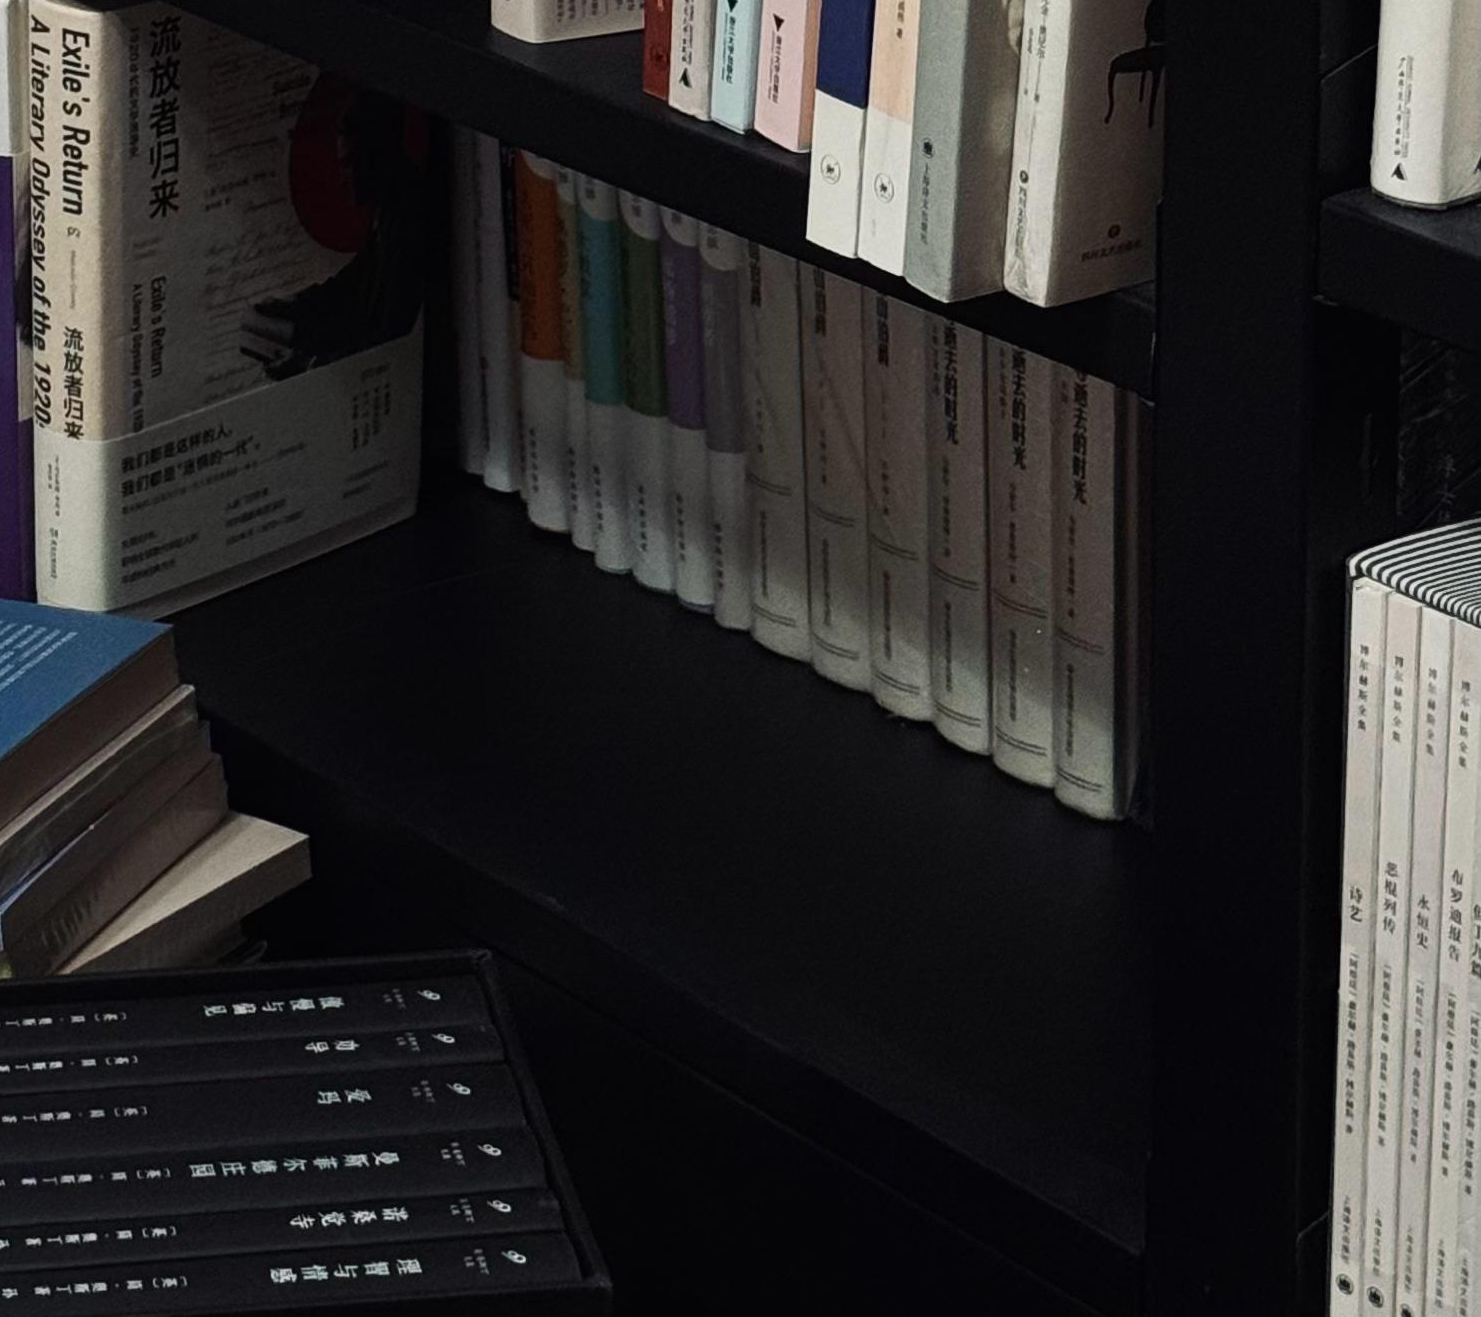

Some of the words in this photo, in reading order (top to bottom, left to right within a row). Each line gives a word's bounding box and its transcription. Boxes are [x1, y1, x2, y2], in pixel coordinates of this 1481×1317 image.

[30, 14, 51, 34] A
[61, 27, 91, 118] Exile's
[29, 42, 51, 153] Literary
[149, 15, 183, 219] 流放者归来
[61, 124, 91, 217] Return
[30, 157, 51, 273] Odyssey
[33, 275, 52, 309] of
[33, 308, 52, 352] the
[63, 325, 85, 441] 流放者归来
[1349, 885, 1364, 923] 诗艺
[1382, 861, 1399, 936] 恶棍列传
[1447, 868, 1464, 963] 布罗迪报告
[1415, 893, 1430, 950] 永恒史
[203, 995, 345, 1017] 傲慢与偏见
[304, 1038, 360, 1053] 劝导
[317, 1087, 373, 1105] 爱玛
[190, 1150, 400, 1179] 曼斯菲尔德庄园
[289, 1206, 409, 1230] 诺桑觉寺
[269, 1257, 423, 1285] 理智与情感
